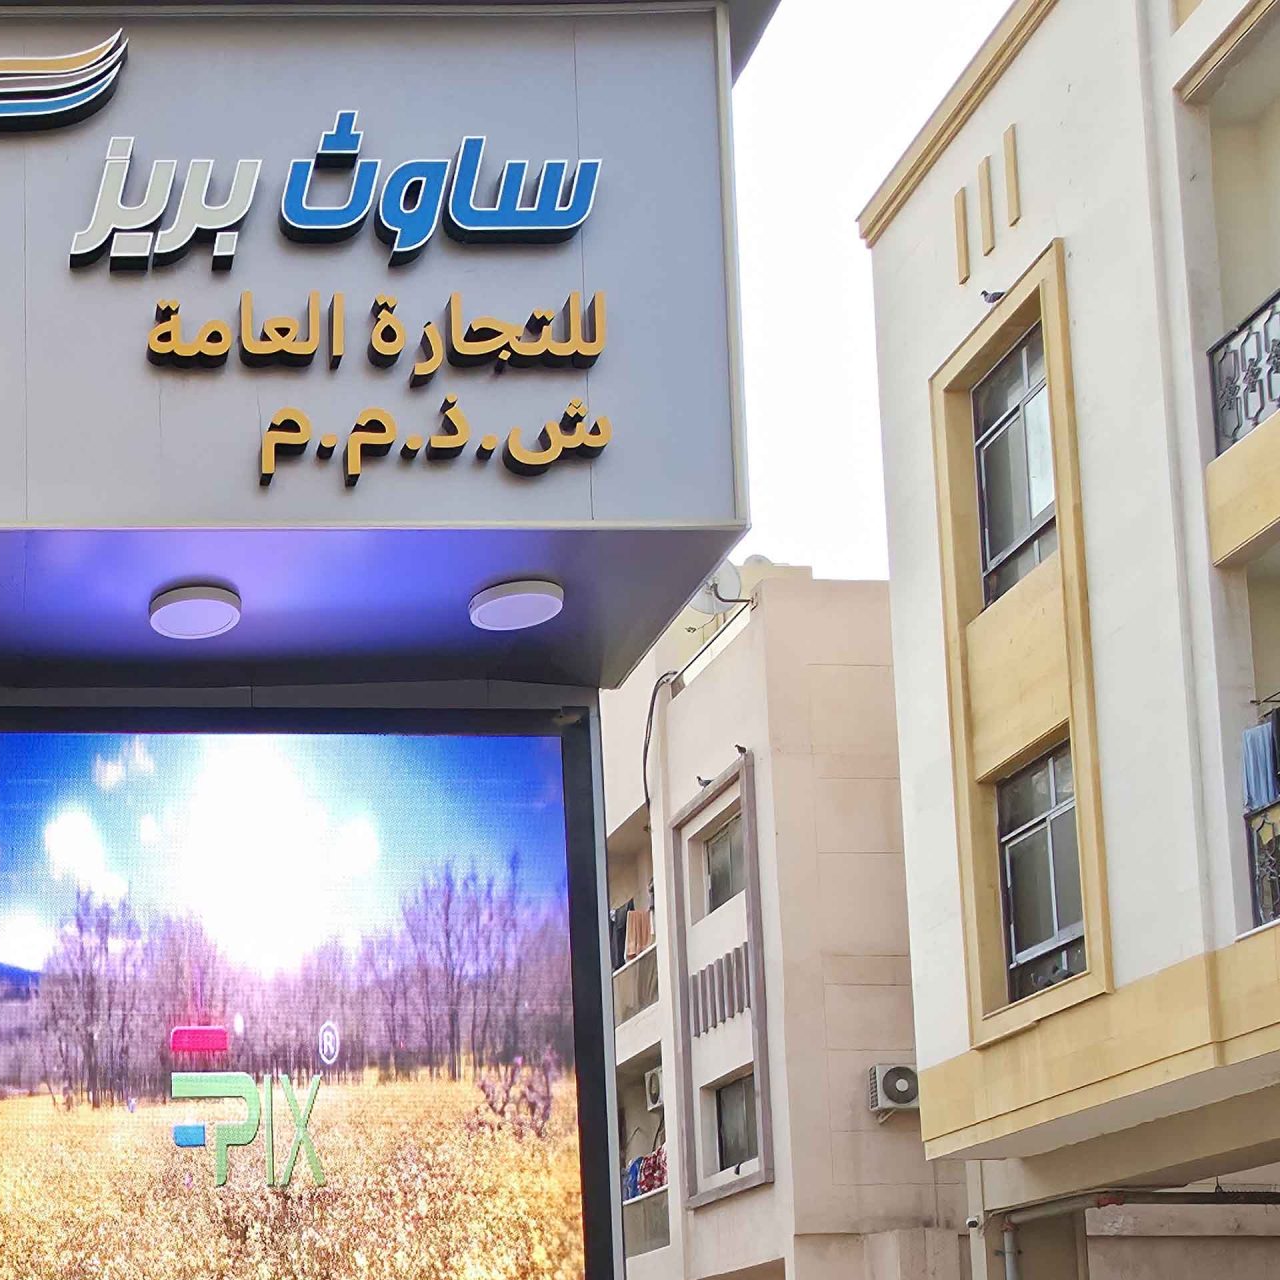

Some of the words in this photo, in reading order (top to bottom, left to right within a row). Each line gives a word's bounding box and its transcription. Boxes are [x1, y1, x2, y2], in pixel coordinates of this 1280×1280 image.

[70, 136, 262, 260] بريز
[281, 110, 603, 254] ساوث
[147, 291, 345, 358] العامة
[369, 292, 607, 380] للتجارة
